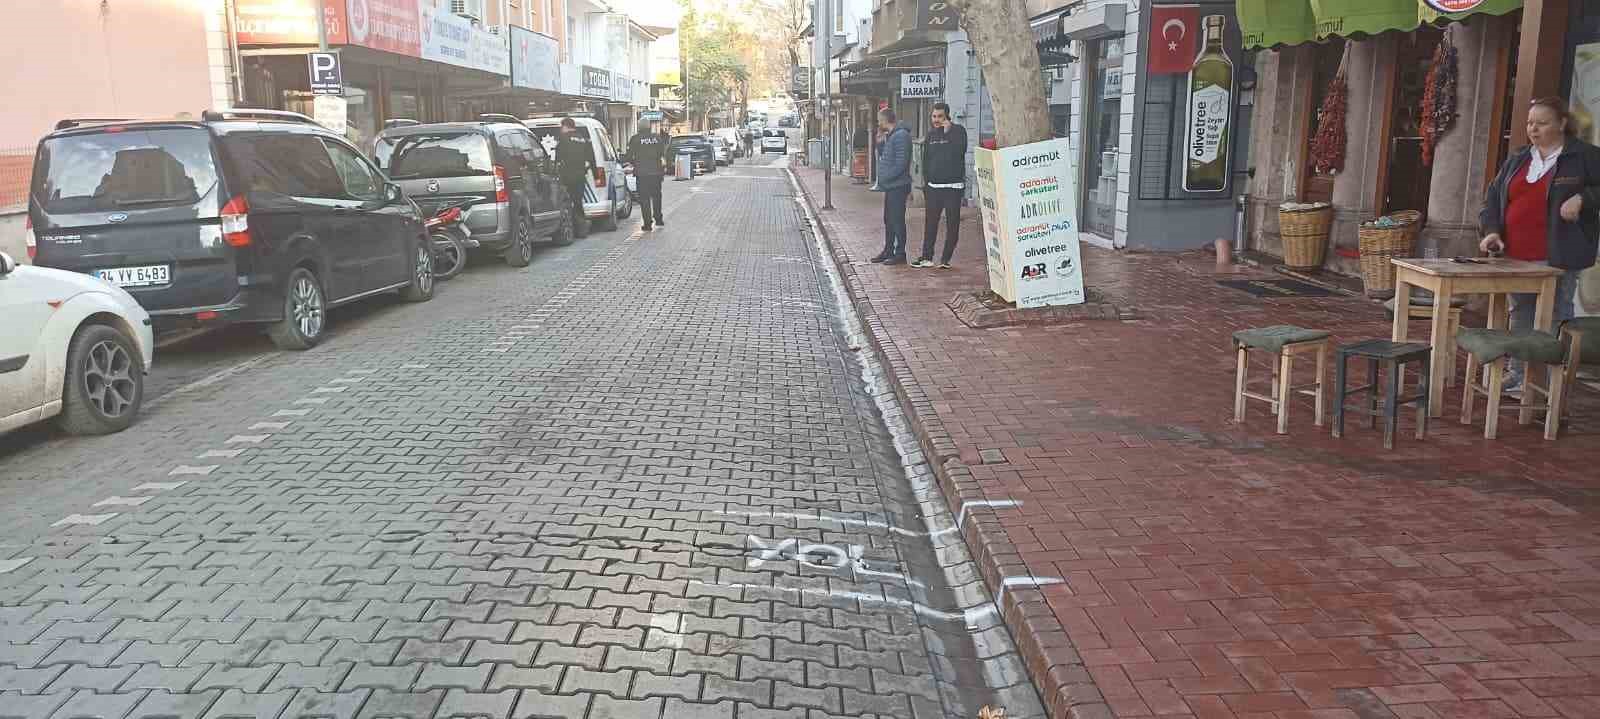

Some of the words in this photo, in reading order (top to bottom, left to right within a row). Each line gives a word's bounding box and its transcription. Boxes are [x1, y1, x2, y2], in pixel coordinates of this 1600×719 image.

[909, 74, 932, 83] DEVA
[903, 87, 938, 96] BAHARAT
[1192, 101, 1207, 157] olivetree
[1025, 244, 1067, 258] olivetree
[137, 267, 167, 281] 6483
